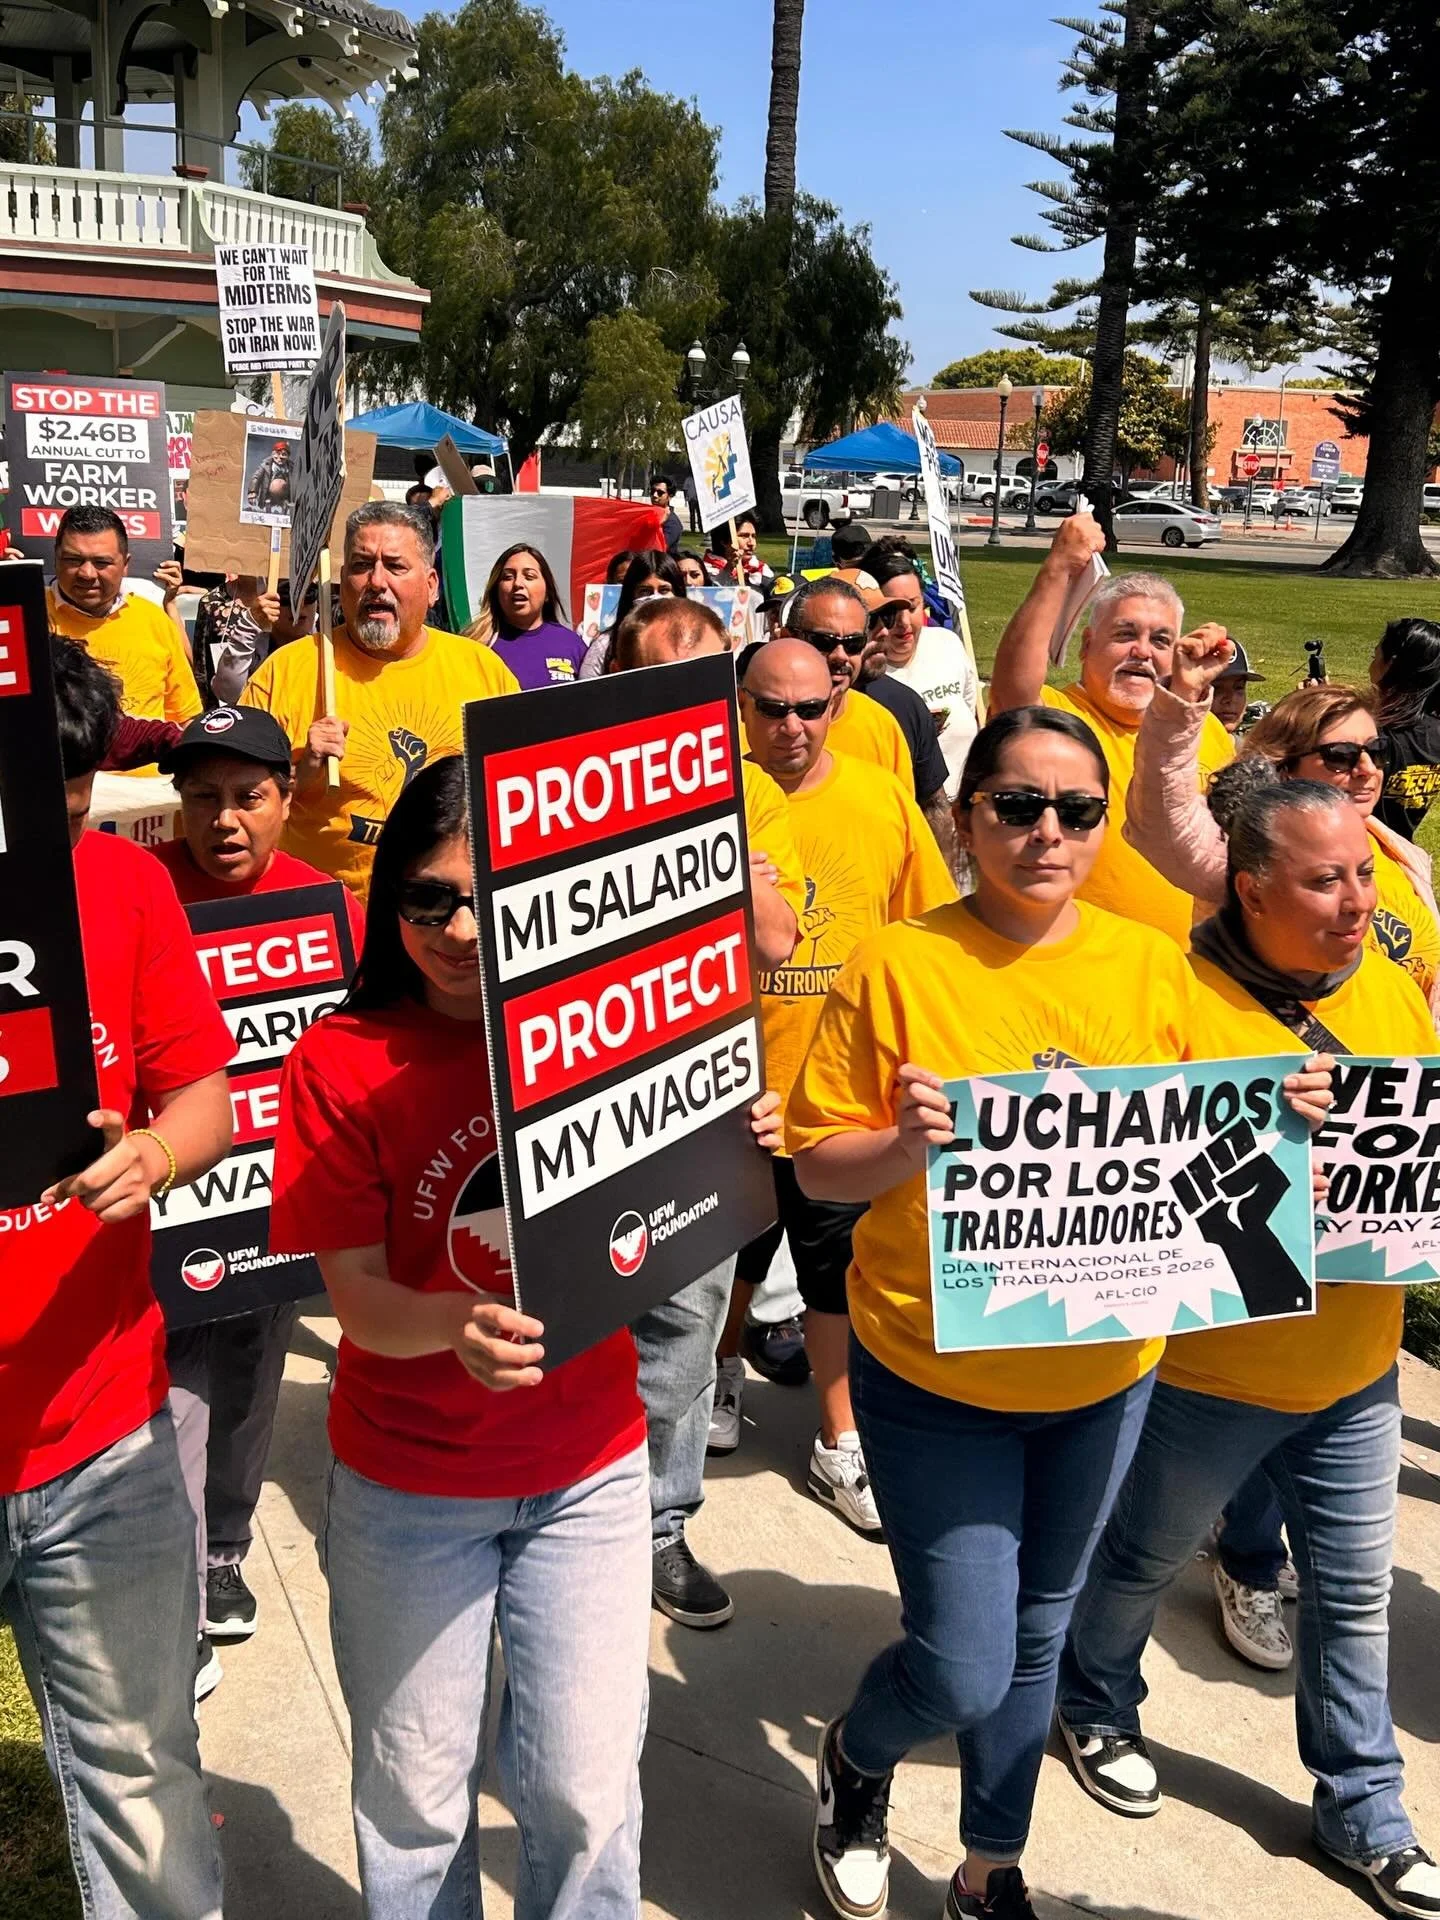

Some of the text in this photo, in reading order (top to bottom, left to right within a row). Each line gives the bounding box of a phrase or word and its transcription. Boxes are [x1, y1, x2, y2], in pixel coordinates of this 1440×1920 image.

[220, 248, 308, 265] WE CAN'T WAIT
[243, 265, 291, 282] FOR THE
[224, 283, 312, 306] MIDTERMS
[226, 316, 315, 334] STOP THE WAR
[229, 334, 316, 353] ON IRAN NOW!
[16, 387, 157, 415] STOP THE
[38, 417, 137, 443] $2.46B
[685, 400, 740, 440] CAUSA
[31, 445, 146, 460] ANNUAL CUT TO
[45, 462, 127, 485] FARM
[23, 484, 157, 508] WORKER
[497, 723, 728, 848] PROTEGE
[501, 831, 737, 961] MI SALARIO
[196, 930, 334, 987] TEGE
[519, 933, 741, 1087] PROTECT
[531, 1036, 751, 1194] MY WAGES
[940, 1077, 1276, 1153] LUCHAMOS
[413, 1150, 453, 1220] UFW
[944, 1158, 1161, 1201] POR LOS
[649, 1199, 676, 1227] UFW
[651, 1191, 719, 1246] FOUNDATION
[942, 1201, 1182, 1252] TRABAJADORES
[1361, 1218, 1422, 1234] DAY
[227, 1246, 260, 1262] UFW
[942, 1249, 1183, 1274] DÍA INTERNACIONAL DE
[944, 1258, 1215, 1289] LOS TRABAJADORES 2026
[1094, 1286, 1158, 1301] AFL-CIO
